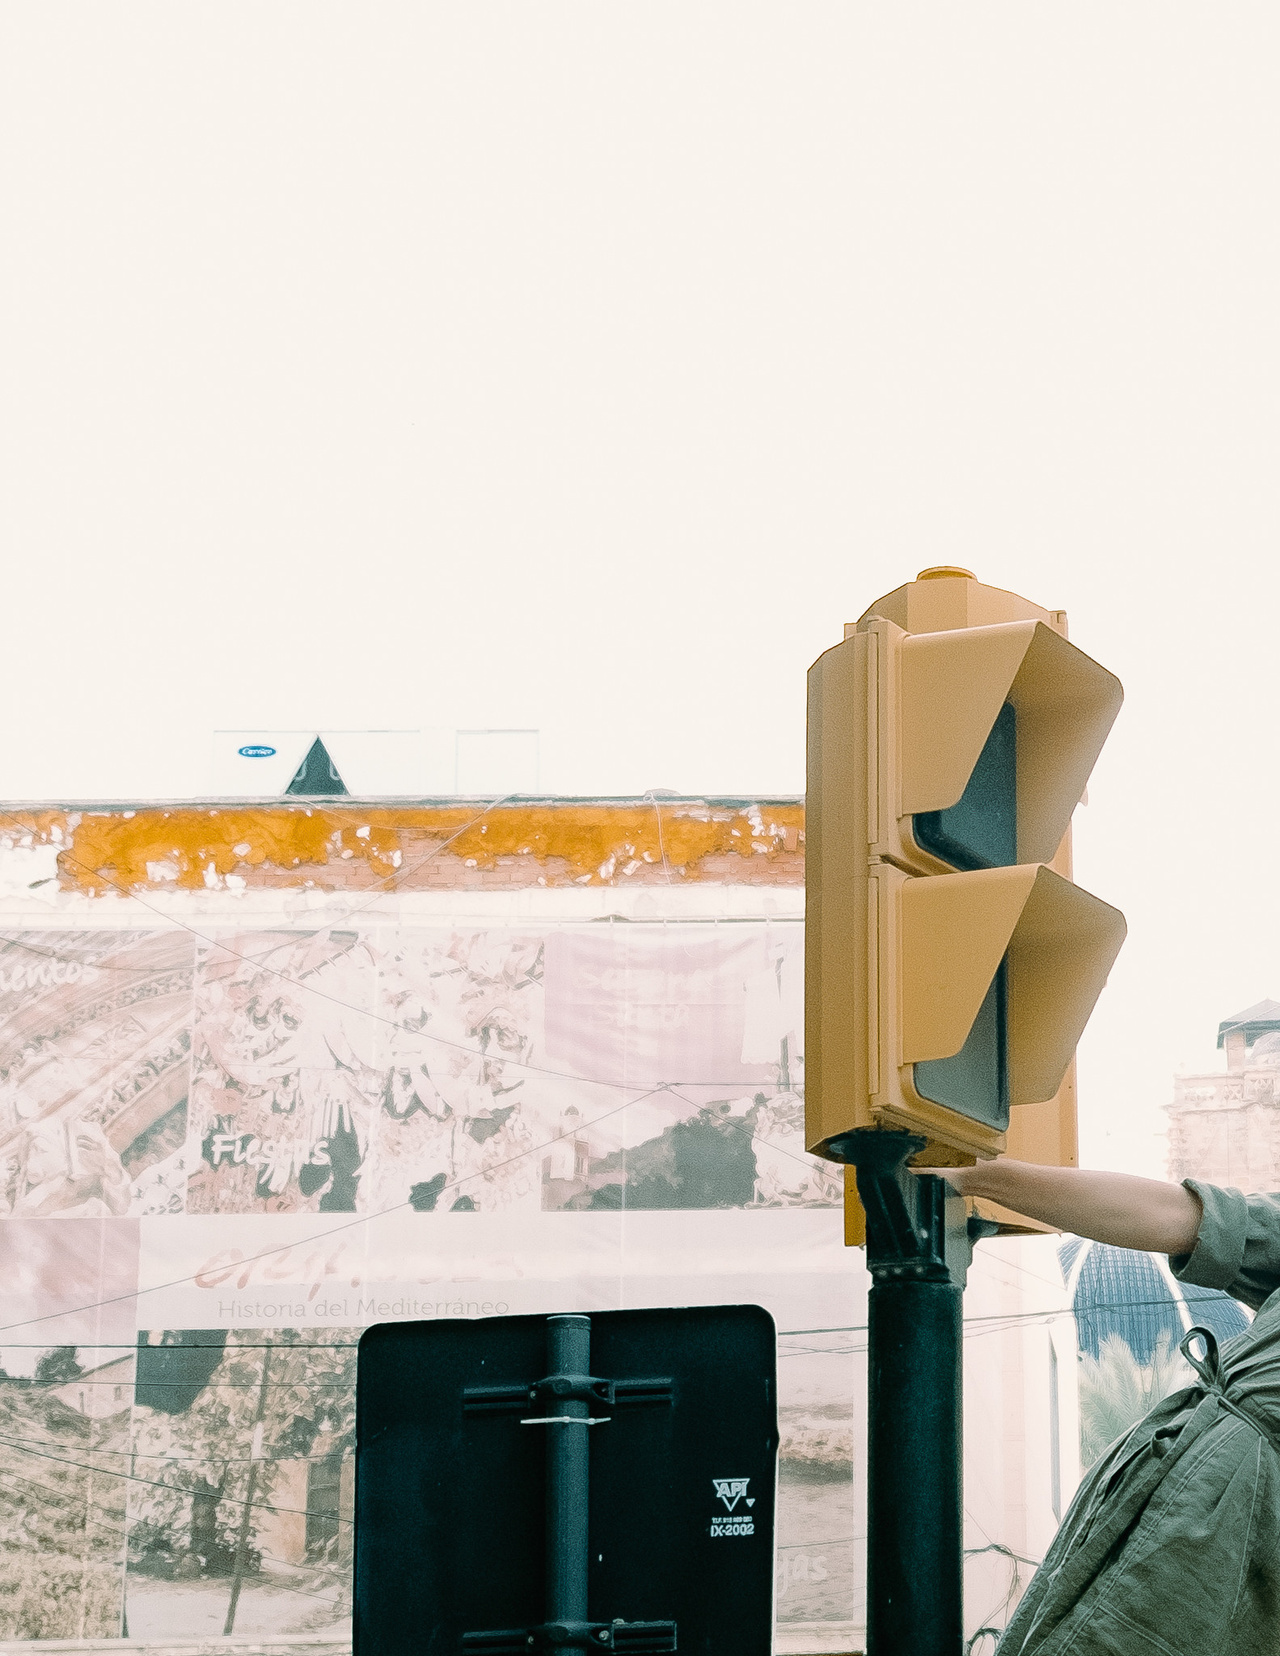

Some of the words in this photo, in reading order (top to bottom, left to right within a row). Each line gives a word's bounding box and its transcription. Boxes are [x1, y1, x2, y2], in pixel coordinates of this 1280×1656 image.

[219, 1300, 307, 1318] Historia
[314, 1299, 348, 1317] del
[355, 1298, 510, 1317] Mediterráneo
[716, 1482, 747, 1498] API
[710, 1523, 755, 1537] IX-2002
